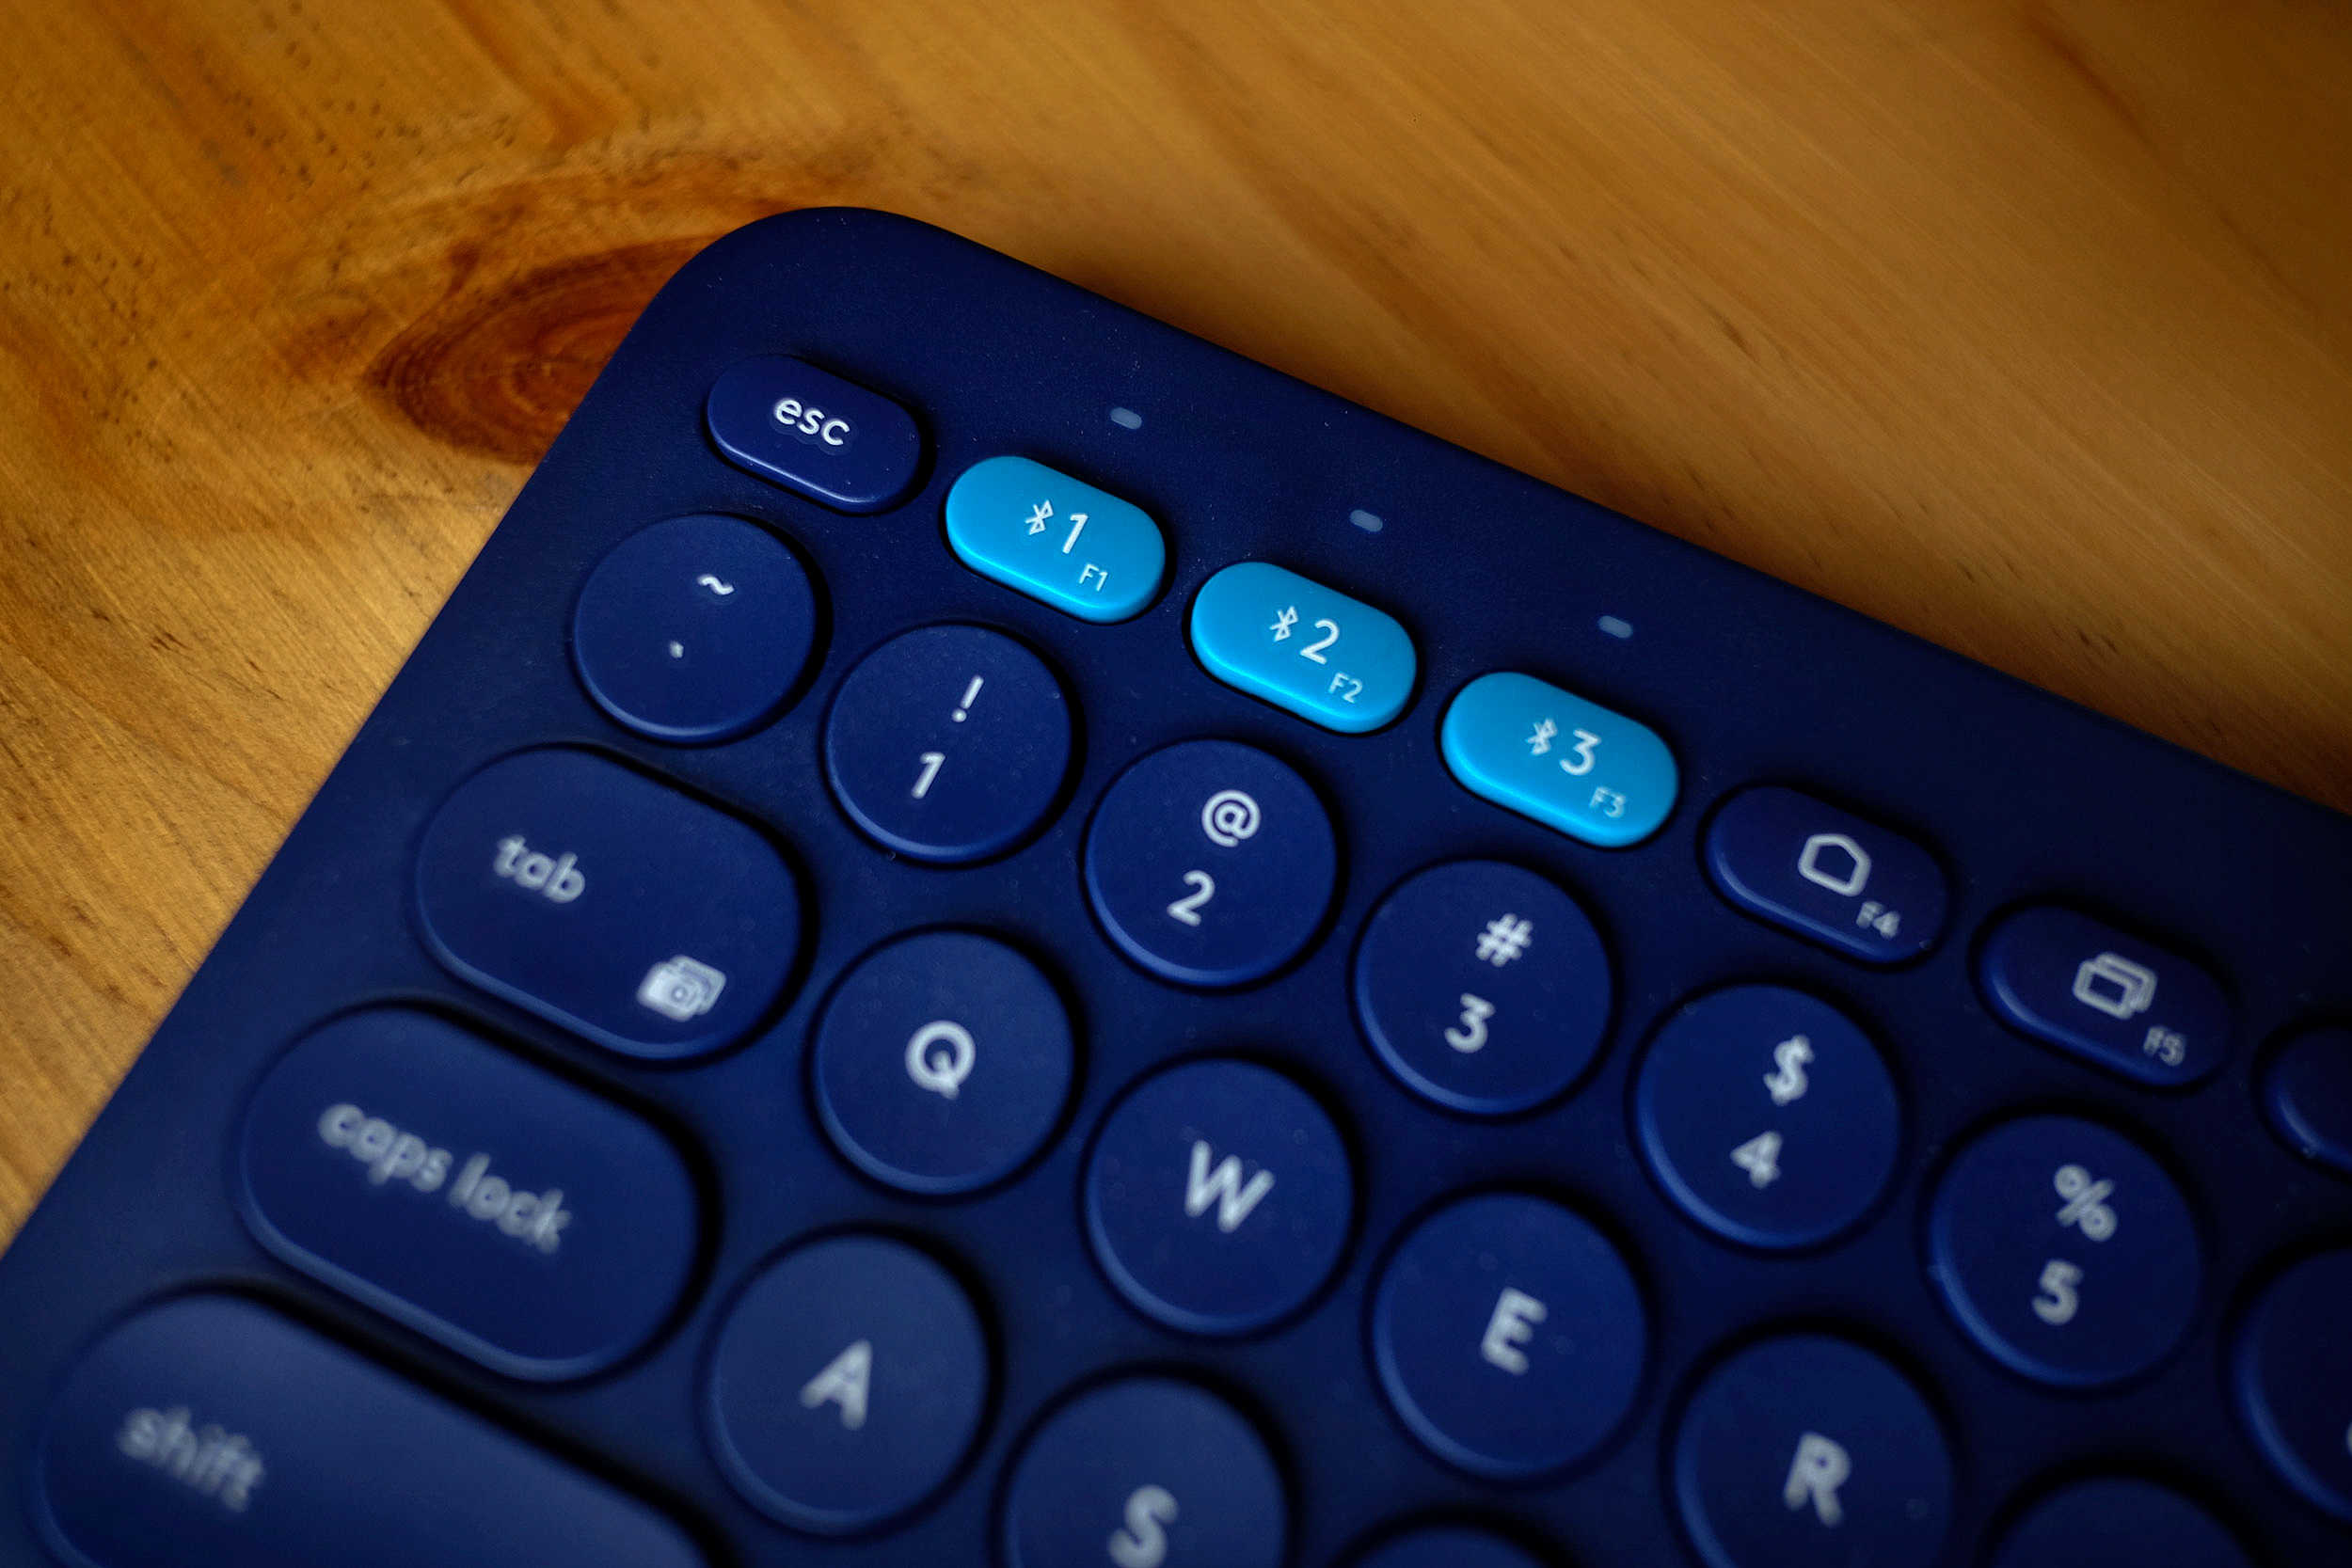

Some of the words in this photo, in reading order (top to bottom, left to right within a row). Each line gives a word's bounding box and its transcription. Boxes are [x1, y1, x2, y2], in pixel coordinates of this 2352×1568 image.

[773, 398, 850, 446] esc
[1062, 513, 1089, 554] 1
[1078, 563, 1108, 592] F1
[1300, 619, 1340, 665] 2
[952, 675, 984, 722] !
[1329, 672, 1363, 704] F2
[912, 752, 946, 799] 1
[1560, 729, 1601, 776] 3
[1201, 789, 1261, 847] @
[1590, 786, 1627, 817] F3
[495, 836, 585, 903] tab
[1168, 870, 1216, 926] 2
[1476, 914, 1531, 966] #
[1855, 901, 1899, 938] F4
[1444, 993, 1494, 1053] 3
[2143, 1026, 2185, 1066] F5
[906, 1021, 976, 1098] Q
[1764, 1036, 1812, 1103] $
[317, 1102, 453, 1193] caps
[449, 1150, 572, 1255] lock
[1185, 1141, 1273, 1230] W
[1732, 1132, 1781, 1185] 4
[2054, 1164, 2116, 1241] %
[2033, 1260, 2080, 1323] 5
[1482, 1289, 1545, 1372] E
[800, 1339, 874, 1428] A
[119, 1405, 266, 1511] shift
[1784, 1433, 1851, 1526] R
[1108, 1483, 1179, 1568] S
